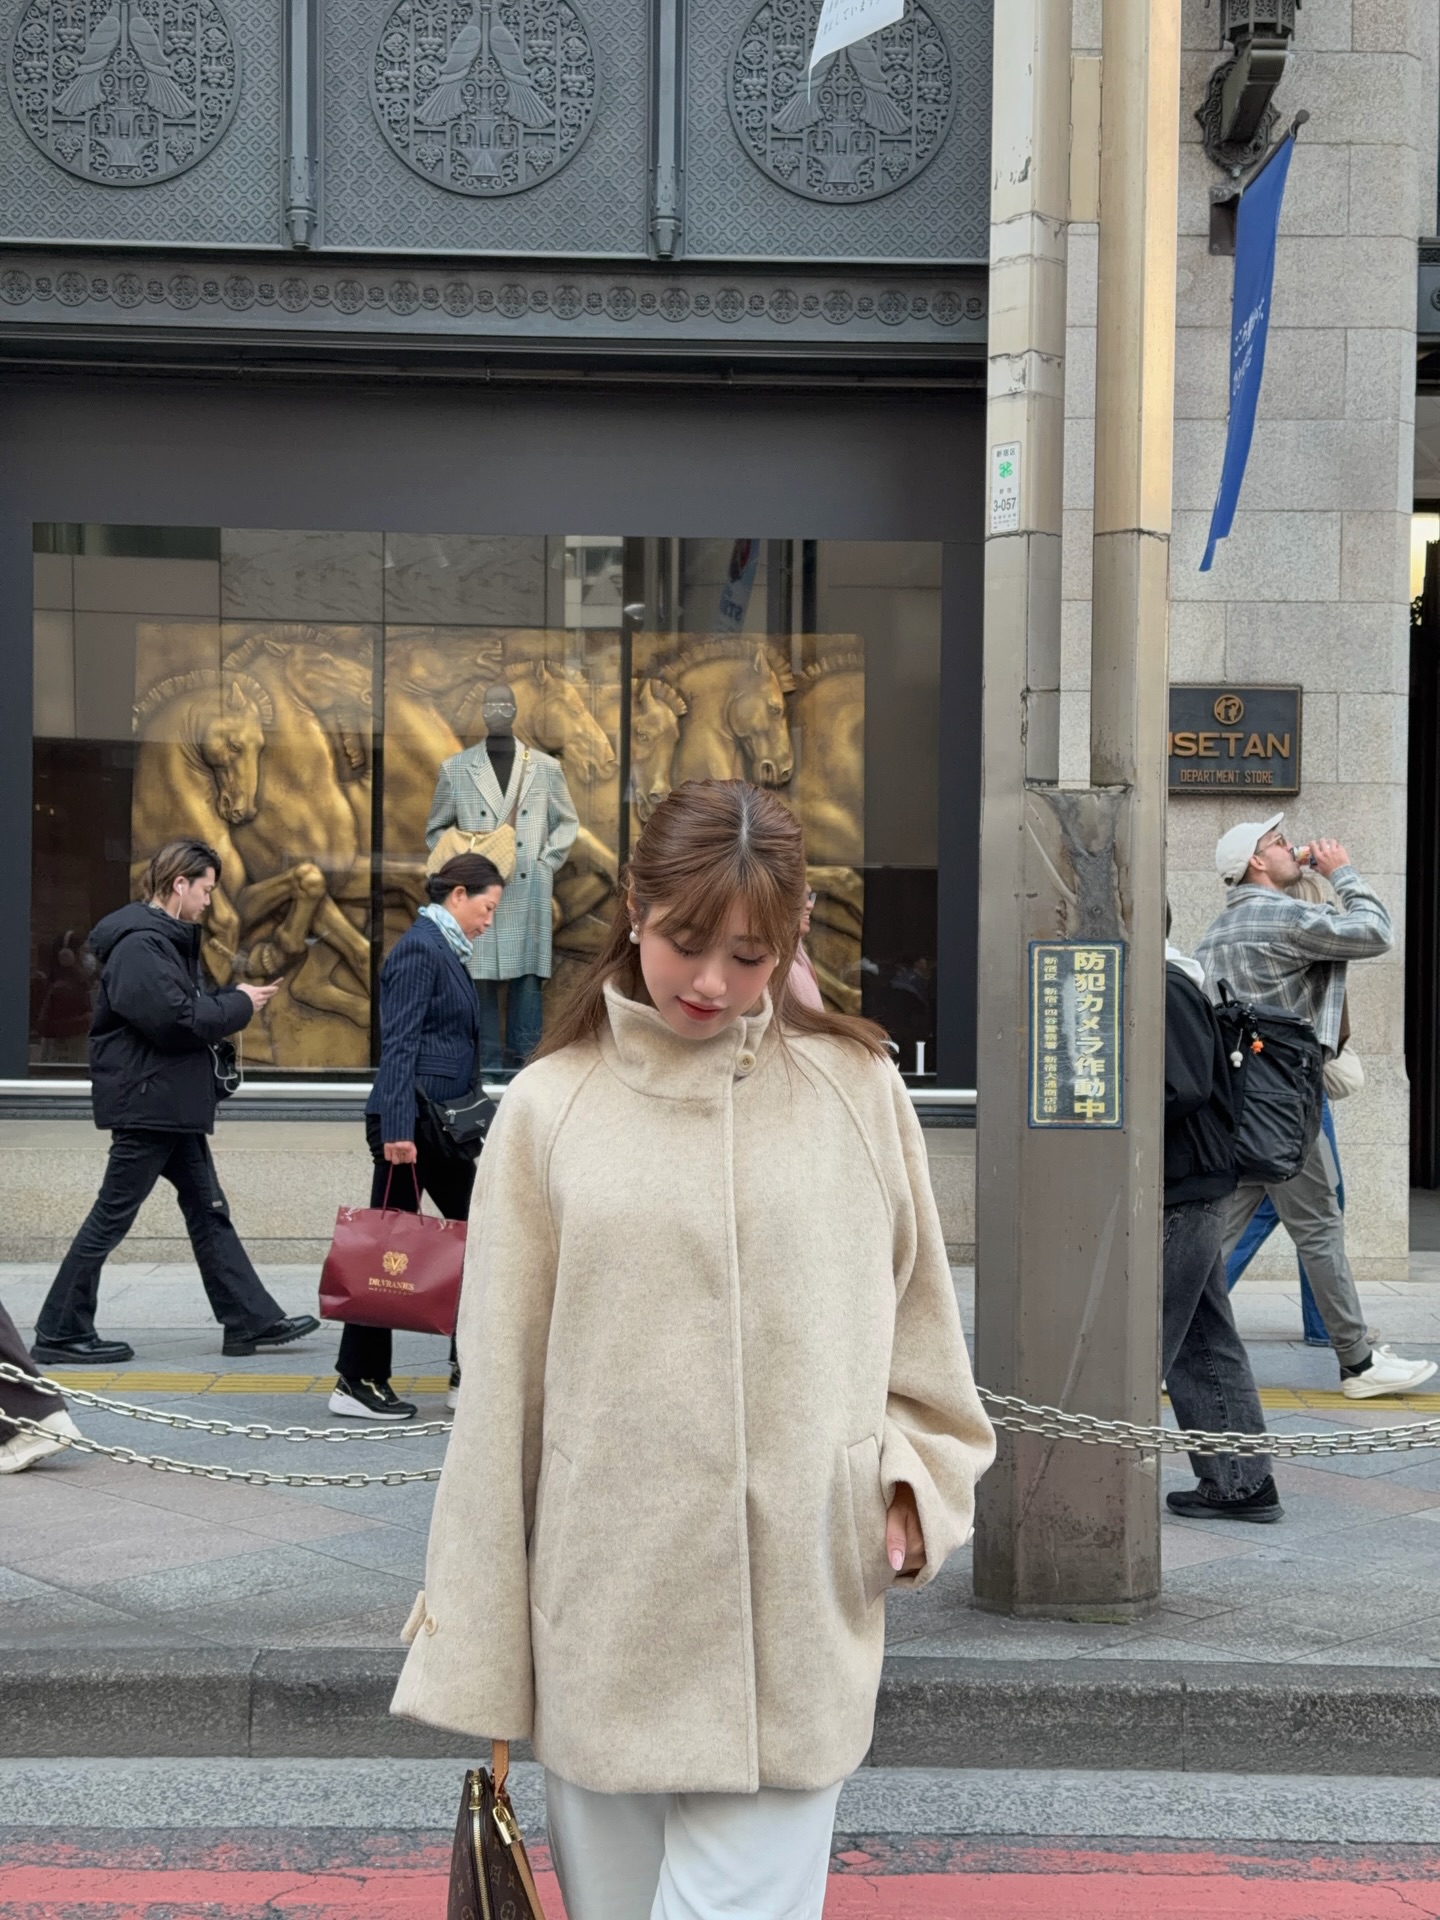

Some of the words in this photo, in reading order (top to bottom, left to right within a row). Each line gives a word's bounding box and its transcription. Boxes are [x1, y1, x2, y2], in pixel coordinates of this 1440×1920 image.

[993, 497, 1017, 512] 3-057
[1168, 732, 1290, 757] ISETAN
[1180, 769, 1240, 783] DEPARTMENT
[1245, 770, 1274, 784] STORE
[1074, 952, 1106, 1120] 防犯カメラ作動中
